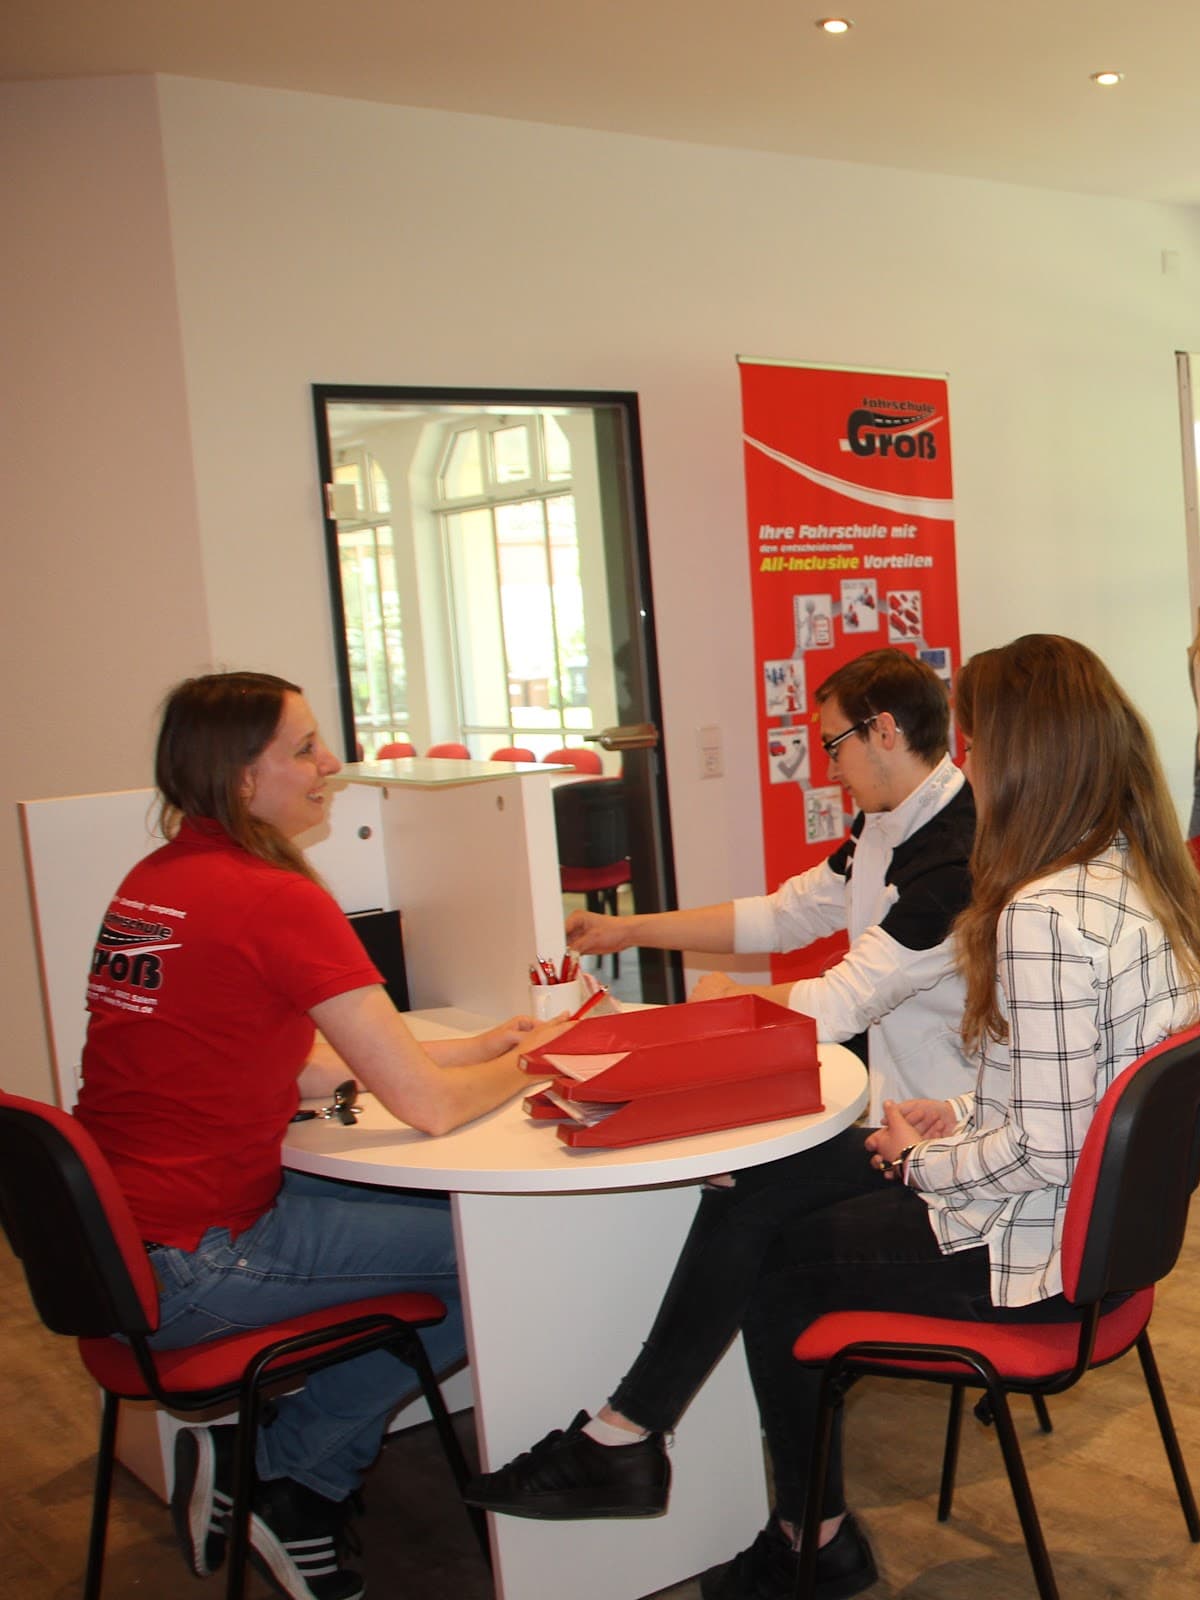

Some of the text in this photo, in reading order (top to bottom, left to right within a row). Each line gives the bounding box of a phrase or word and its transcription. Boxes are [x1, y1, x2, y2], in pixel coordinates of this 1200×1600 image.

[847, 409, 936, 459] Groß
[759, 524, 918, 540] Ihre Fahrschule mit
[864, 555, 933, 569] Vorteilen
